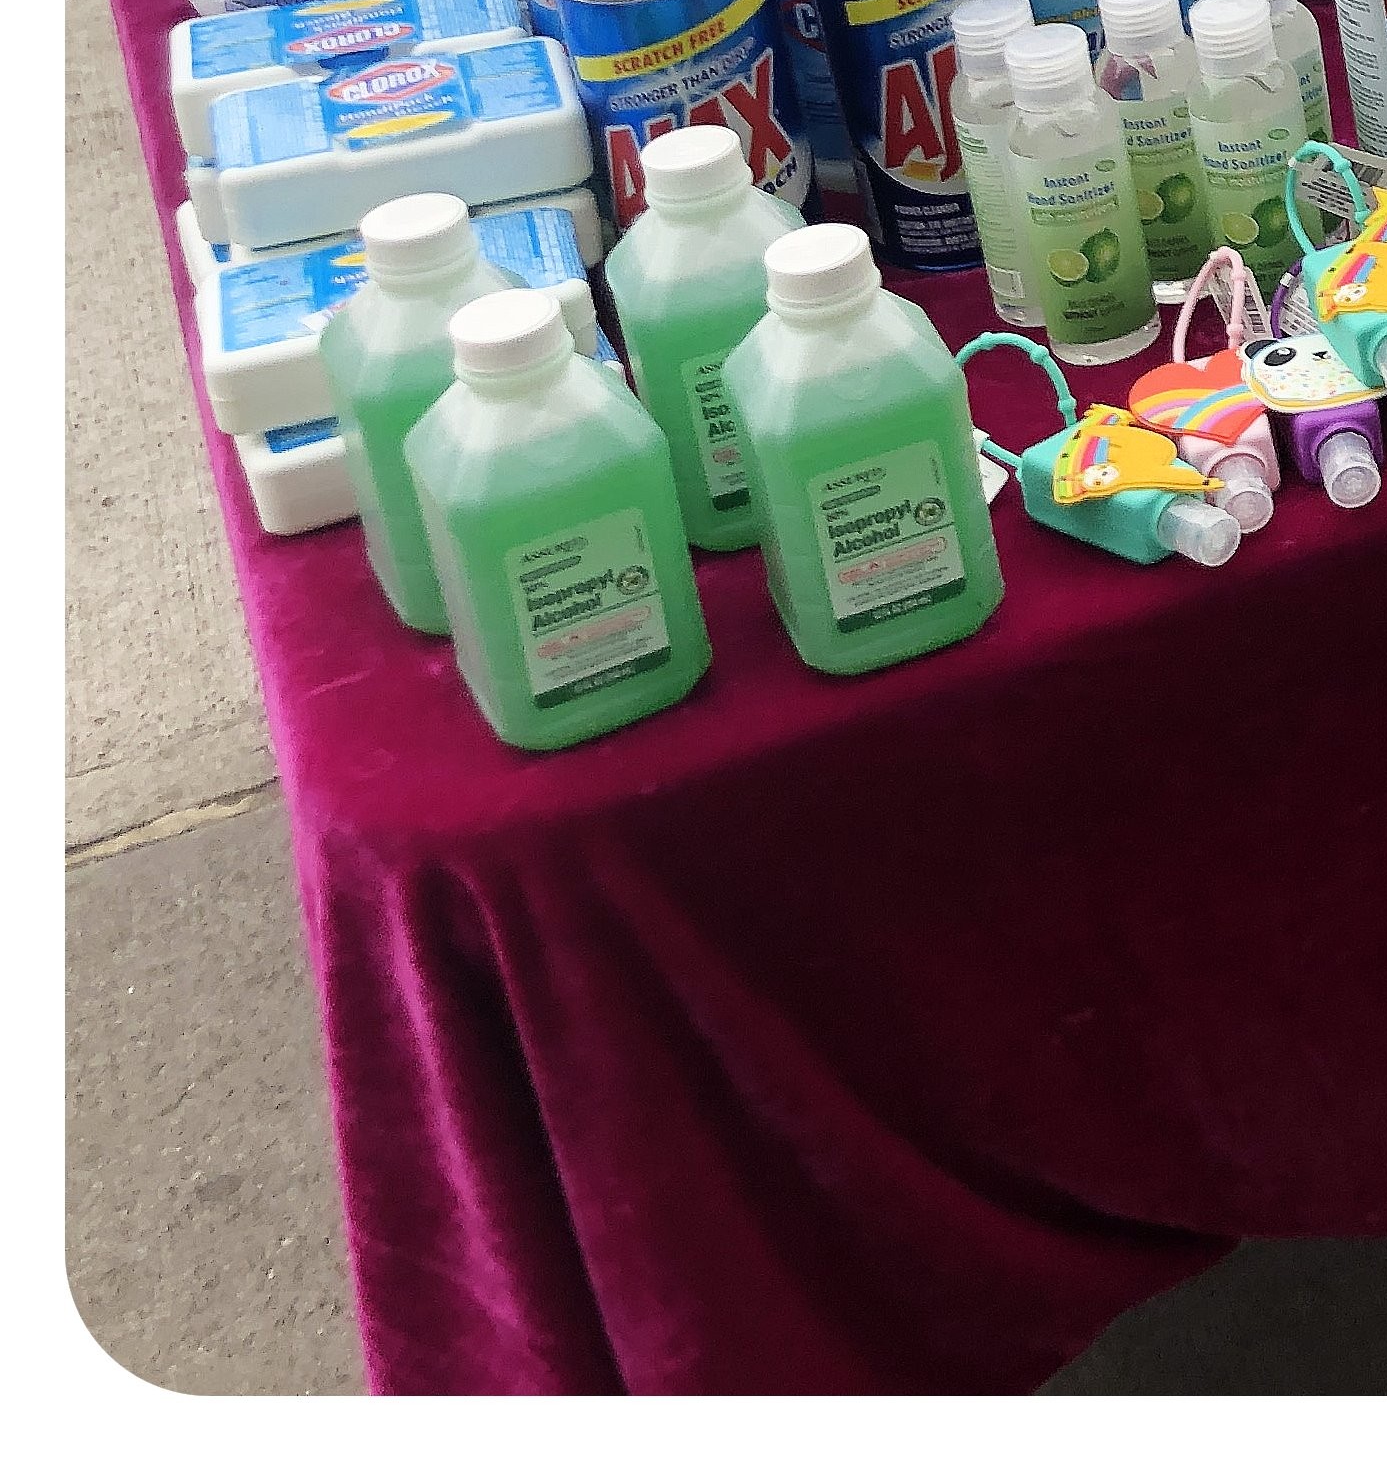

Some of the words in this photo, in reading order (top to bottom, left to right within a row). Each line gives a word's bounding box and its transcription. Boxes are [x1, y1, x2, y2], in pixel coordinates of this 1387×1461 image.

[612, 39, 685, 76] SCRATCH
[687, 16, 727, 51] FREE
[1120, 116, 1167, 131] Instant
[1137, 126, 1193, 148] Sanitizer
[1217, 138, 1263, 153] Instant
[1231, 150, 1288, 171] Sanitizer
[1043, 172, 1090, 188] Instant
[1058, 181, 1115, 206] Sanitizer
[828, 499, 912, 540] Isopropyl
[833, 521, 901, 558] Alcohol
[527, 568, 614, 612] Isopropyl
[531, 592, 602, 631] Alcohol
